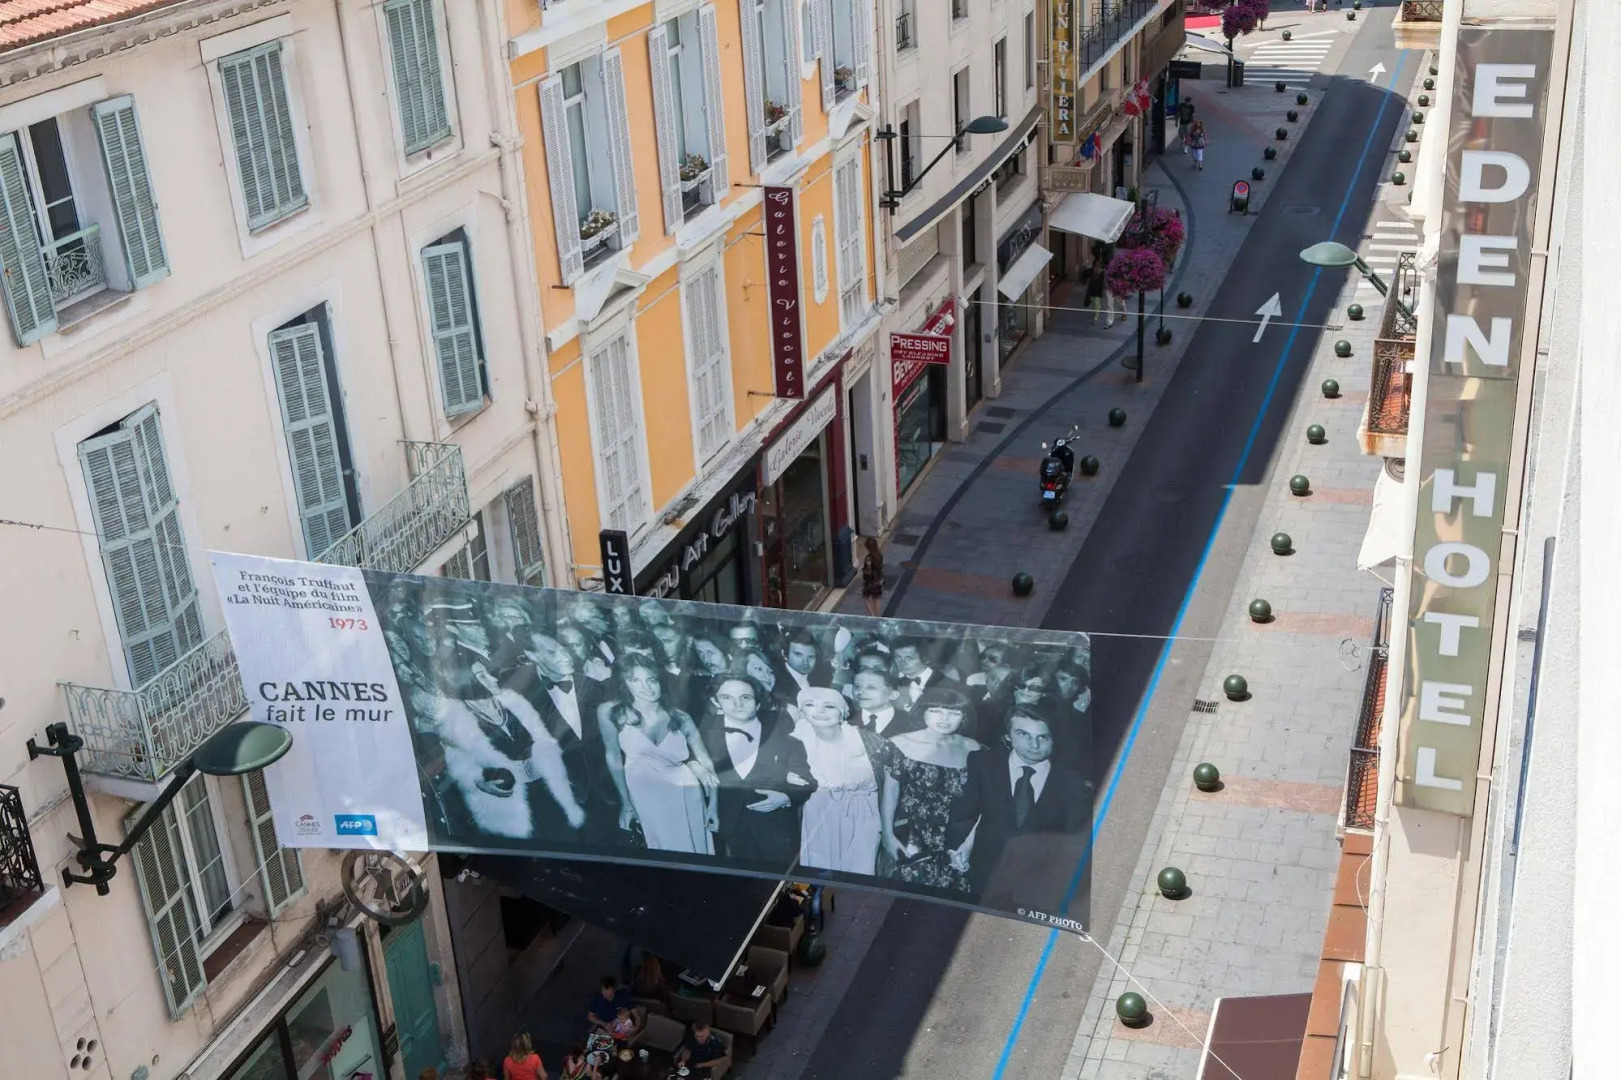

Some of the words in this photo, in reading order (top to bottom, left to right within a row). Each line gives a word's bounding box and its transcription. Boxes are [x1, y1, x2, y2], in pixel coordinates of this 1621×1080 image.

[1058, 40, 1070, 134] RIVIERA
[1444, 63, 1536, 367] EDEN
[768, 191, 790, 286] Galerie
[777, 299, 795, 397] Vieceli
[891, 335, 947, 352] PRESSING
[607, 541, 624, 593] LUX
[239, 570, 296, 587] François
[297, 577, 356, 591] Truffaut
[238, 584, 251, 593] et
[253, 583, 307, 600] l'équipe
[311, 589, 328, 600] du
[330, 591, 361, 602] film
[252, 594, 281, 606] Nuit
[328, 617, 368, 631] 1973
[1415, 468, 1497, 790] HOTEL
[259, 681, 388, 702] CANNES
[266, 704, 306, 722] fait
[315, 704, 336, 722] le
[345, 708, 393, 722] mur
[340, 821, 362, 830] AFP
[1028, 910, 1047, 921] AFP
[1049, 915, 1083, 930] PHOTO
